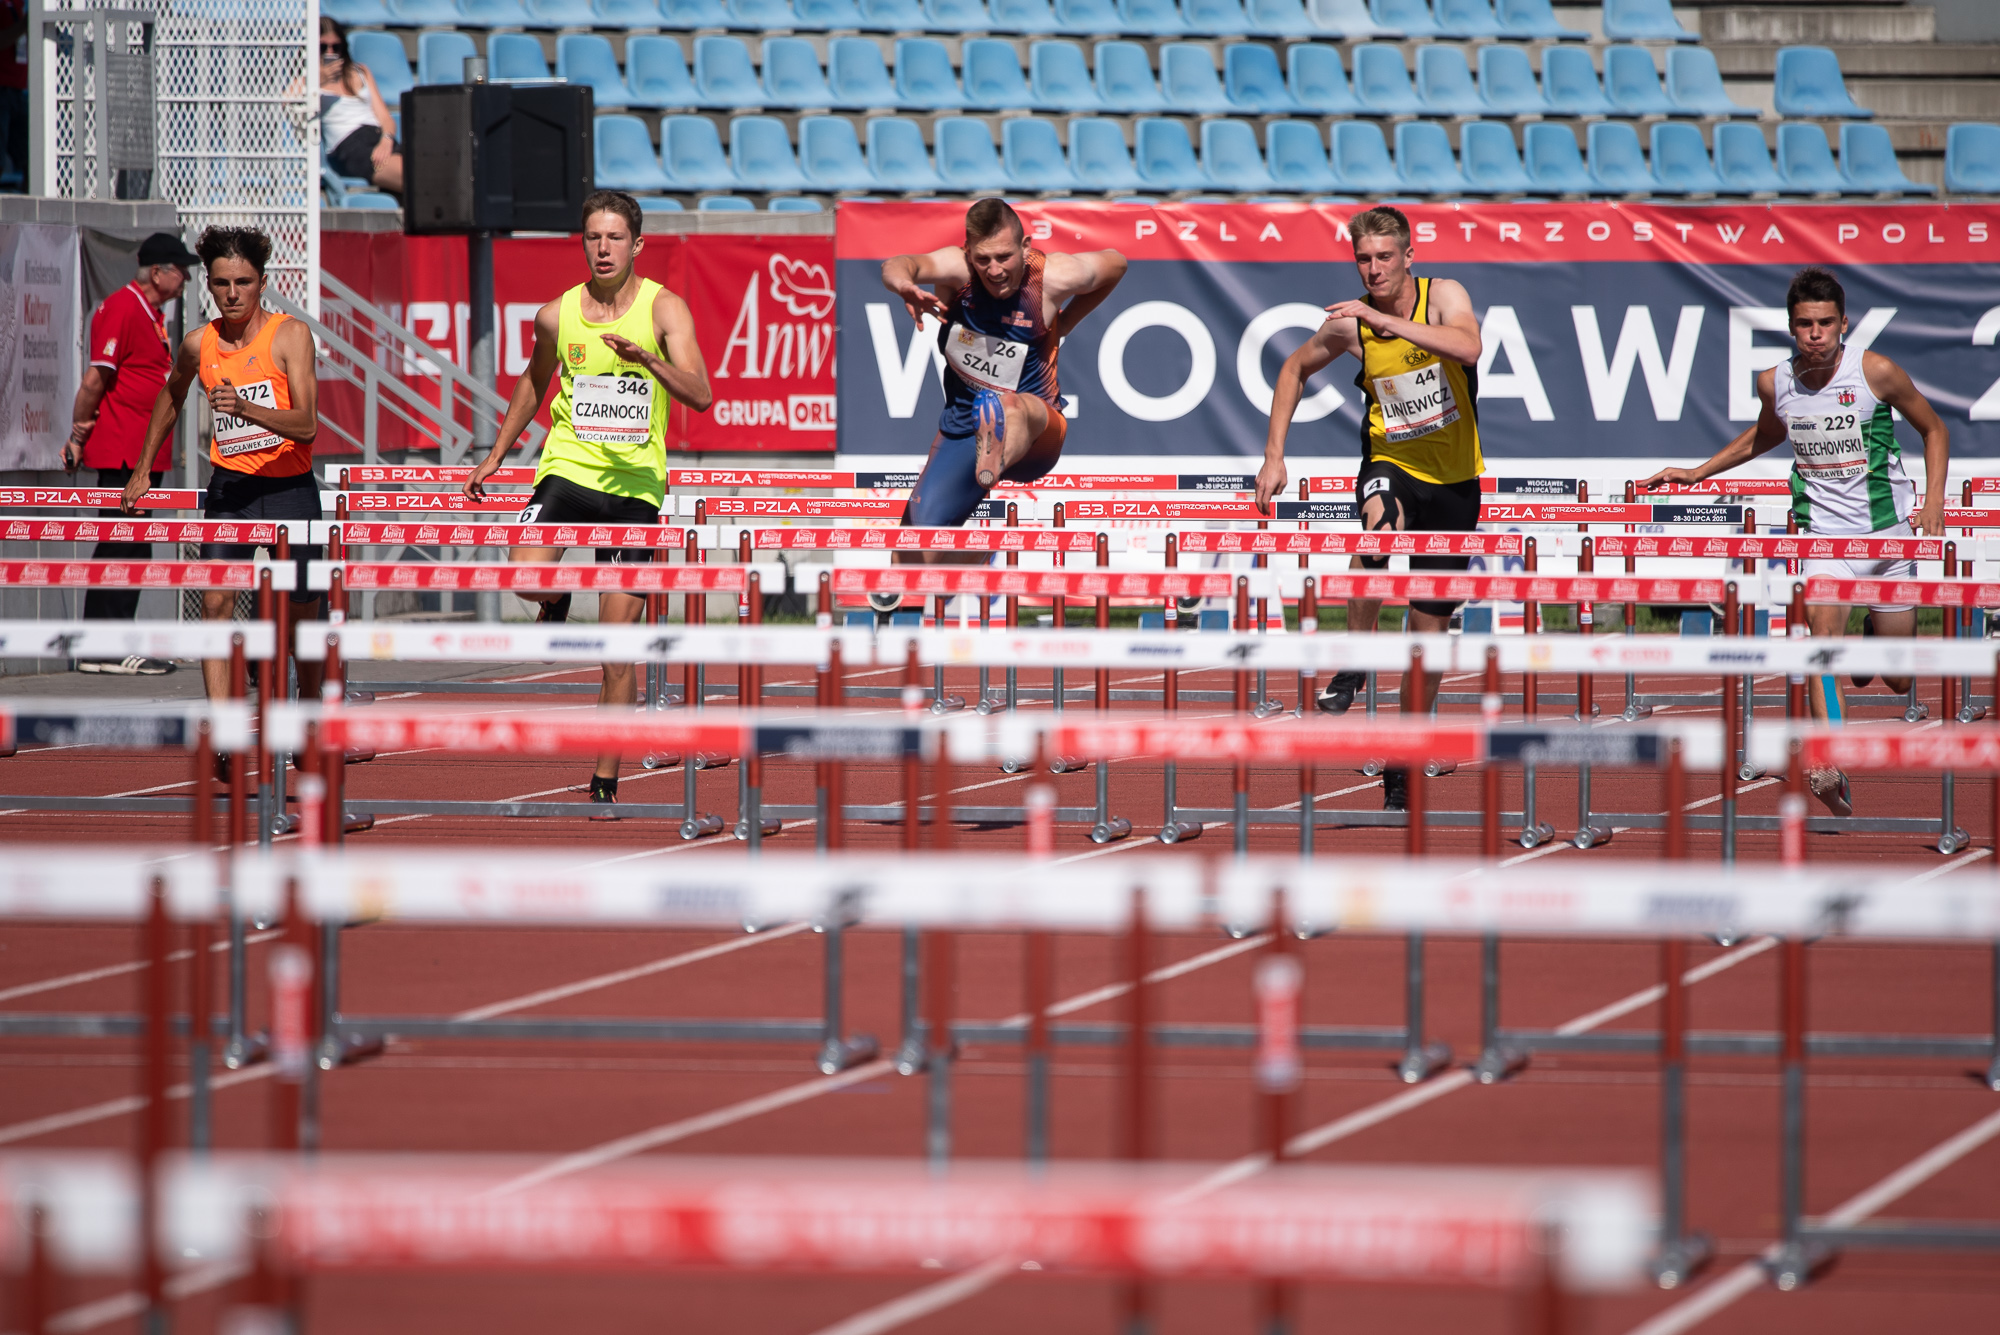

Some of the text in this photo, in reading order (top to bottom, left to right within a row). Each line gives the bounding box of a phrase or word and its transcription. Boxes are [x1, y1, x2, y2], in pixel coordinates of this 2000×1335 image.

[1031, 220, 1083, 240] 3.
[1135, 219, 1284, 243] PZLA
[1334, 220, 1786, 245] MSTRZOSTWA
[994, 341, 1016, 359] 26
[962, 353, 1000, 378] SZAL
[1415, 369, 1436, 386] 44
[617, 380, 649, 396] 346
[1384, 387, 1452, 419] LINIEWICZ
[575, 402, 649, 420] CZARNOCKI
[713, 399, 788, 426] GRUPA
[1391, 413, 1456, 441] WŁOCŁAWEK 2021
[1824, 414, 1856, 431] 229
[263, 436, 281, 446] 2021
[576, 433, 626, 441] WŁOCŁAWEK
[361, 469, 434, 481] 53. PZLA
[680, 472, 753, 484] 53. PZLA
[1801, 466, 1864, 479] WŁOCŁAWEK 2021
[1033, 476, 1075, 487] PZLA
[1321, 479, 1348, 490] 53.
[1368, 479, 1384, 491] 4
[0, 491, 29, 503] 53.
[34, 492, 82, 504] PZLA
[362, 496, 443, 508] 53. PZLA
[719, 501, 801, 513] 53. PZLA
[1079, 504, 1161, 515] 53. PZLA
[1487, 507, 1536, 518] PZLA
[519, 507, 534, 522] 6
